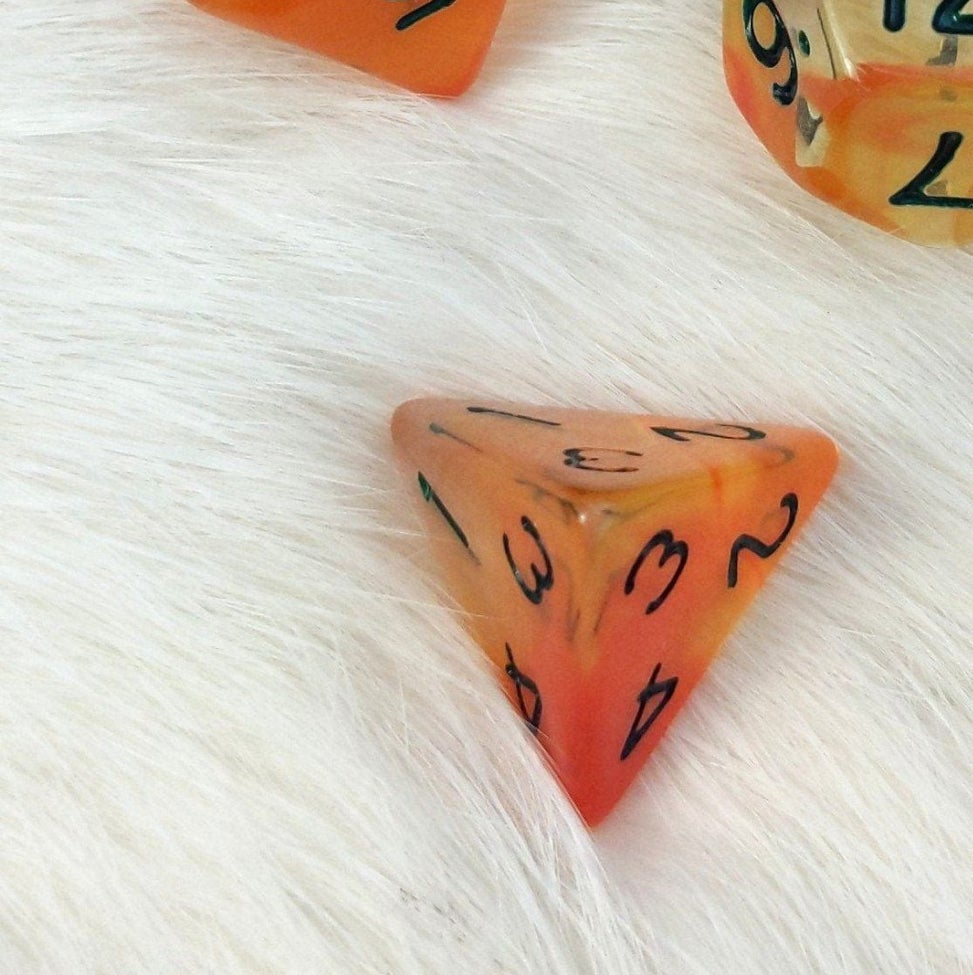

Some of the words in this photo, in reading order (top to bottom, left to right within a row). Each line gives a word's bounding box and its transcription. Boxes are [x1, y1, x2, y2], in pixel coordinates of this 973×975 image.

[503, 515, 555, 605] 3
[624, 529, 690, 615] 3
[727, 492, 798, 589] 2
[620, 662, 680, 762] 4
